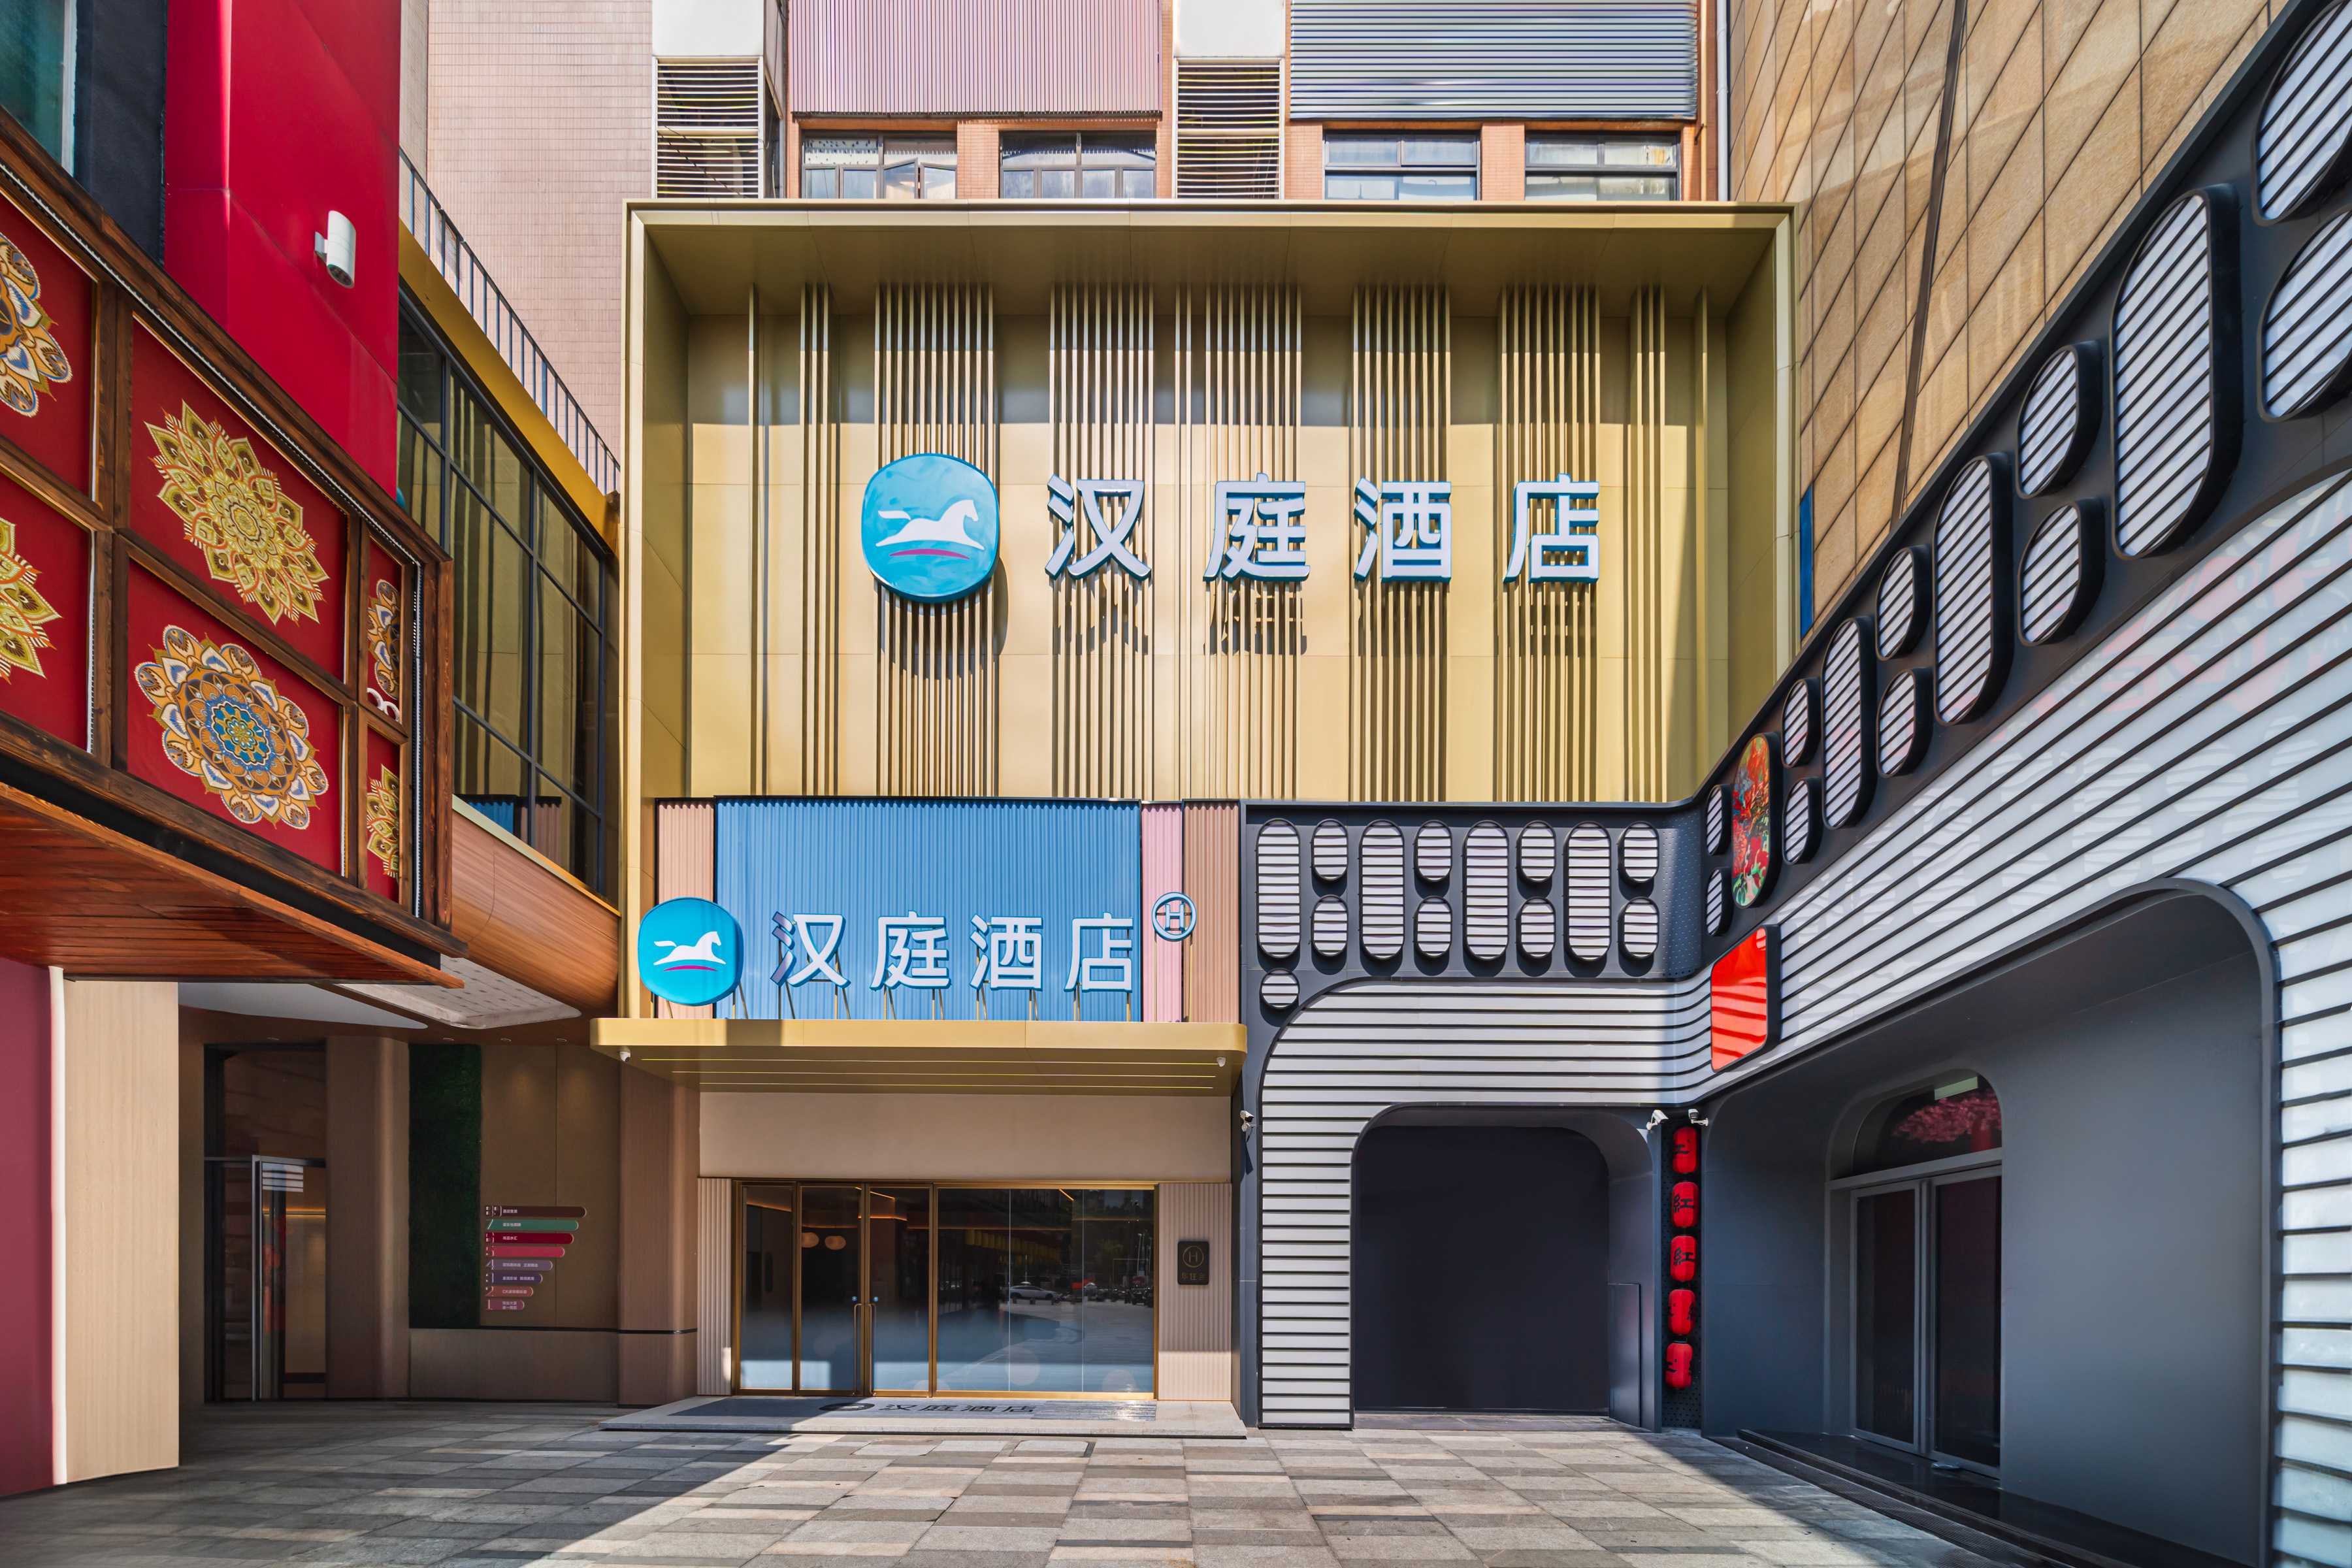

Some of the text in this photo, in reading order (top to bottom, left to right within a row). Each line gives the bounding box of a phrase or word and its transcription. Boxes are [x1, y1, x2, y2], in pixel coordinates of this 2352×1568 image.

[1045, 472, 1599, 583] 汉庭酒店
[770, 910, 1134, 992] 汉庭酒店
[1181, 1272, 1206, 1281] 华住会
[879, 1404, 1037, 1413] 汉庭酒店
